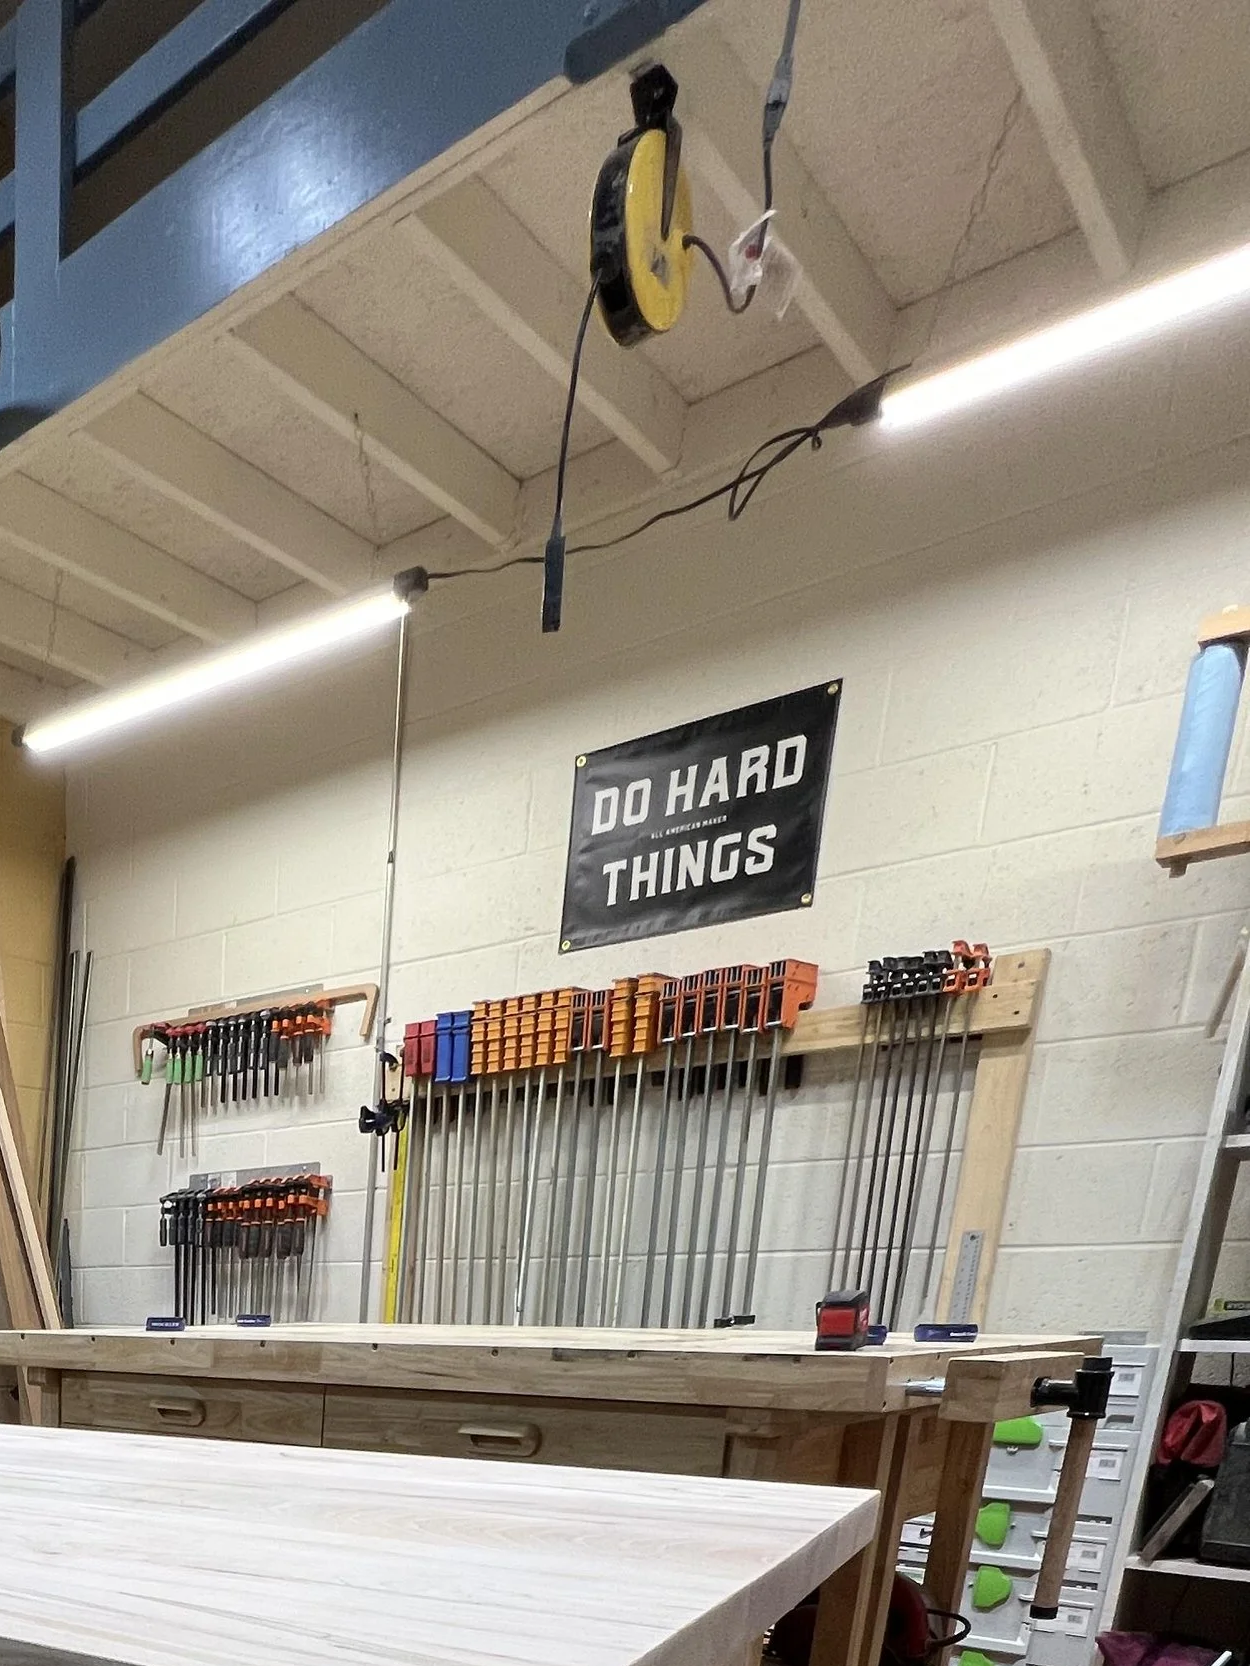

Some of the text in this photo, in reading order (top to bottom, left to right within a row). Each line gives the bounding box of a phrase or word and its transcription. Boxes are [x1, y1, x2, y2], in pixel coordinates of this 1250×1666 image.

[591, 734, 808, 836] DO HARD
[602, 824, 778, 907] THINGS
